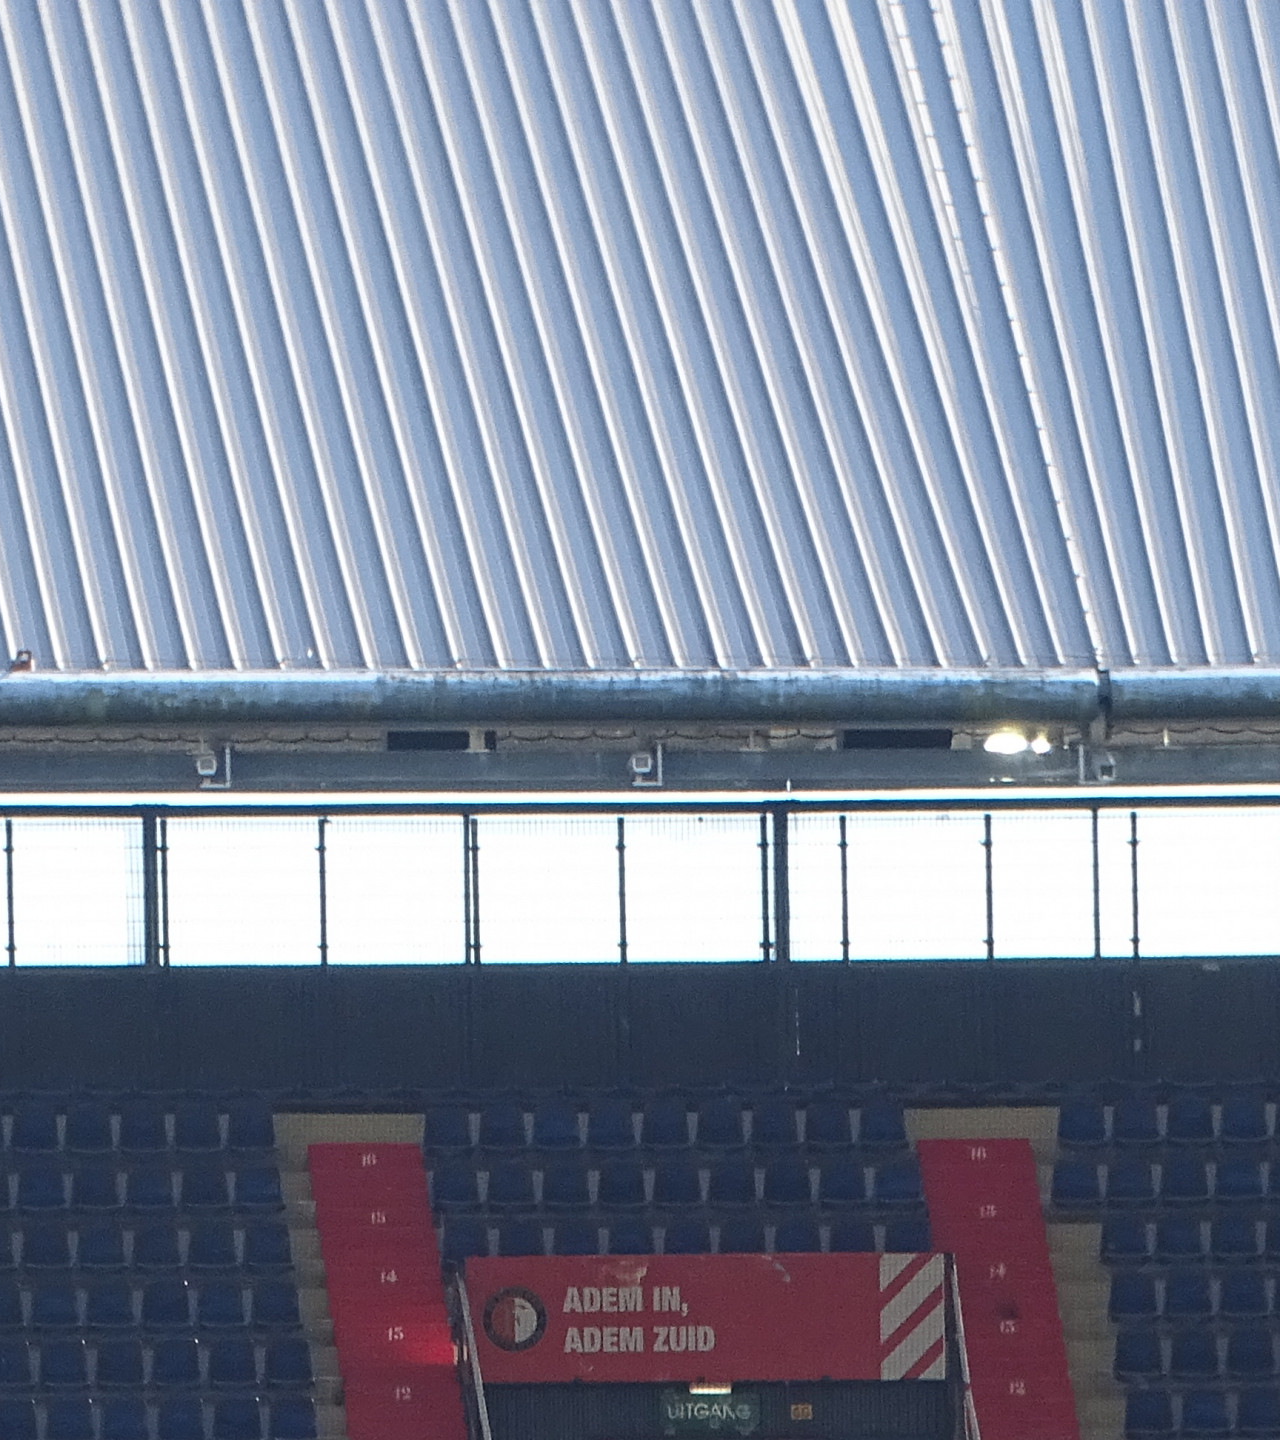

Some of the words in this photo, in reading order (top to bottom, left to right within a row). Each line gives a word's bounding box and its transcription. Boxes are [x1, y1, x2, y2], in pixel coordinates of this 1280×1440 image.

[563, 1286, 644, 1313] ADEM
[652, 1286, 689, 1316] IN,
[564, 1326, 644, 1354] ADEM
[652, 1326, 716, 1353] ZUID
[667, 1403, 752, 1420] UITGANG
